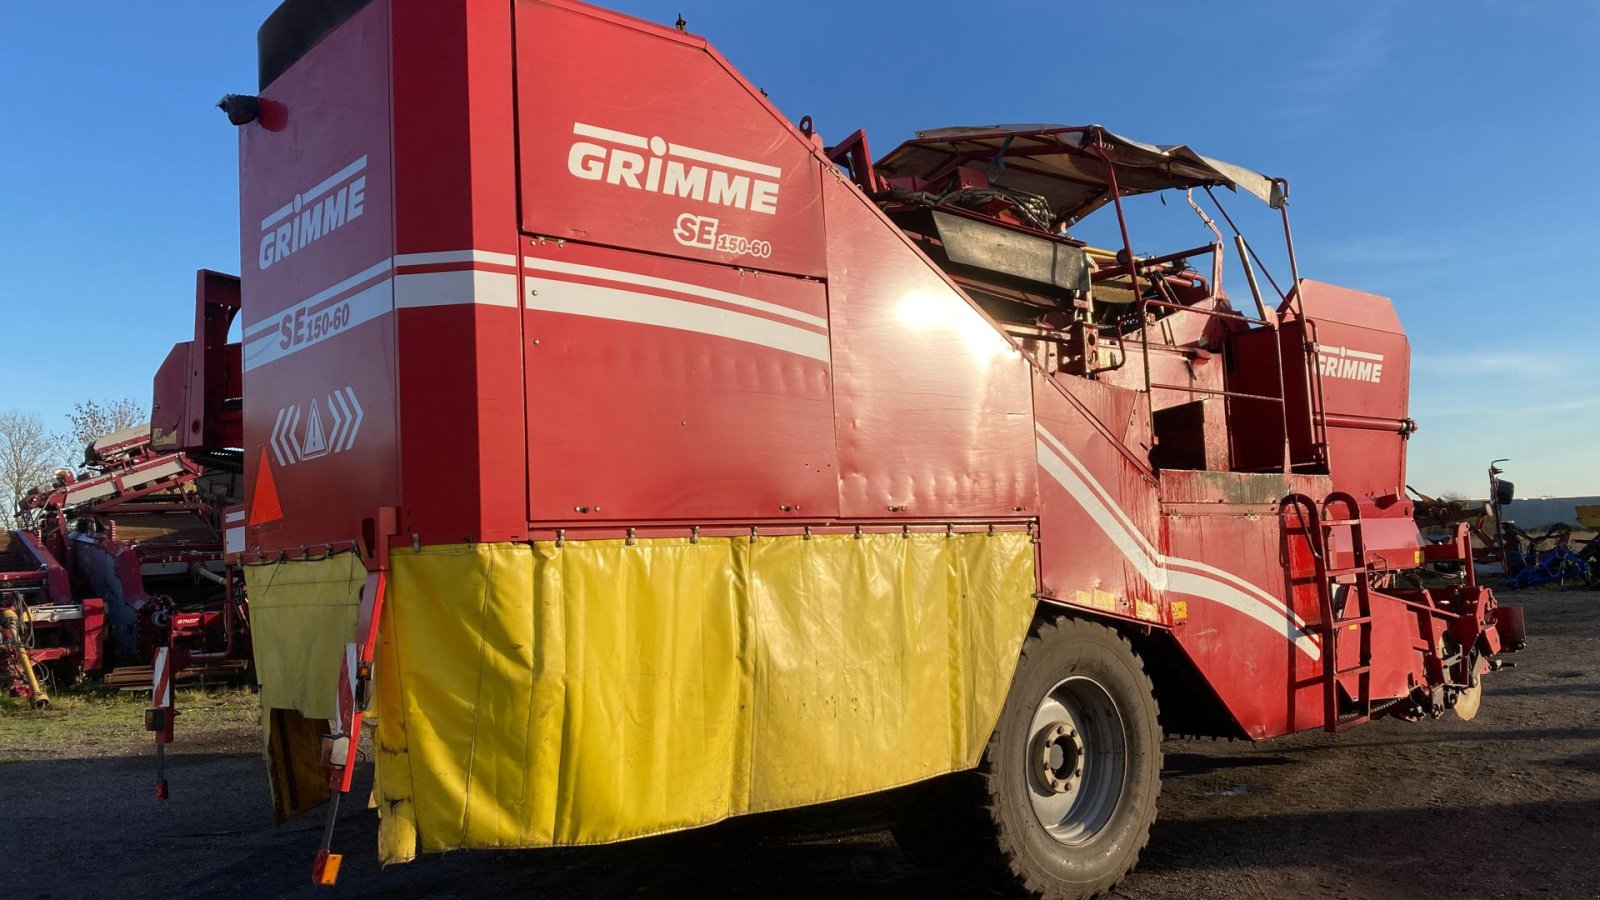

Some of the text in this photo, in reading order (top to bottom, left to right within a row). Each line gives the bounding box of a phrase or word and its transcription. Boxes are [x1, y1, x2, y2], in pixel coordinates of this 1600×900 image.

[567, 135, 780, 215] GRIMME
[258, 174, 367, 270] GRIMME
[673, 212, 772, 258] SE 150-60
[279, 302, 350, 350] SE 150-60
